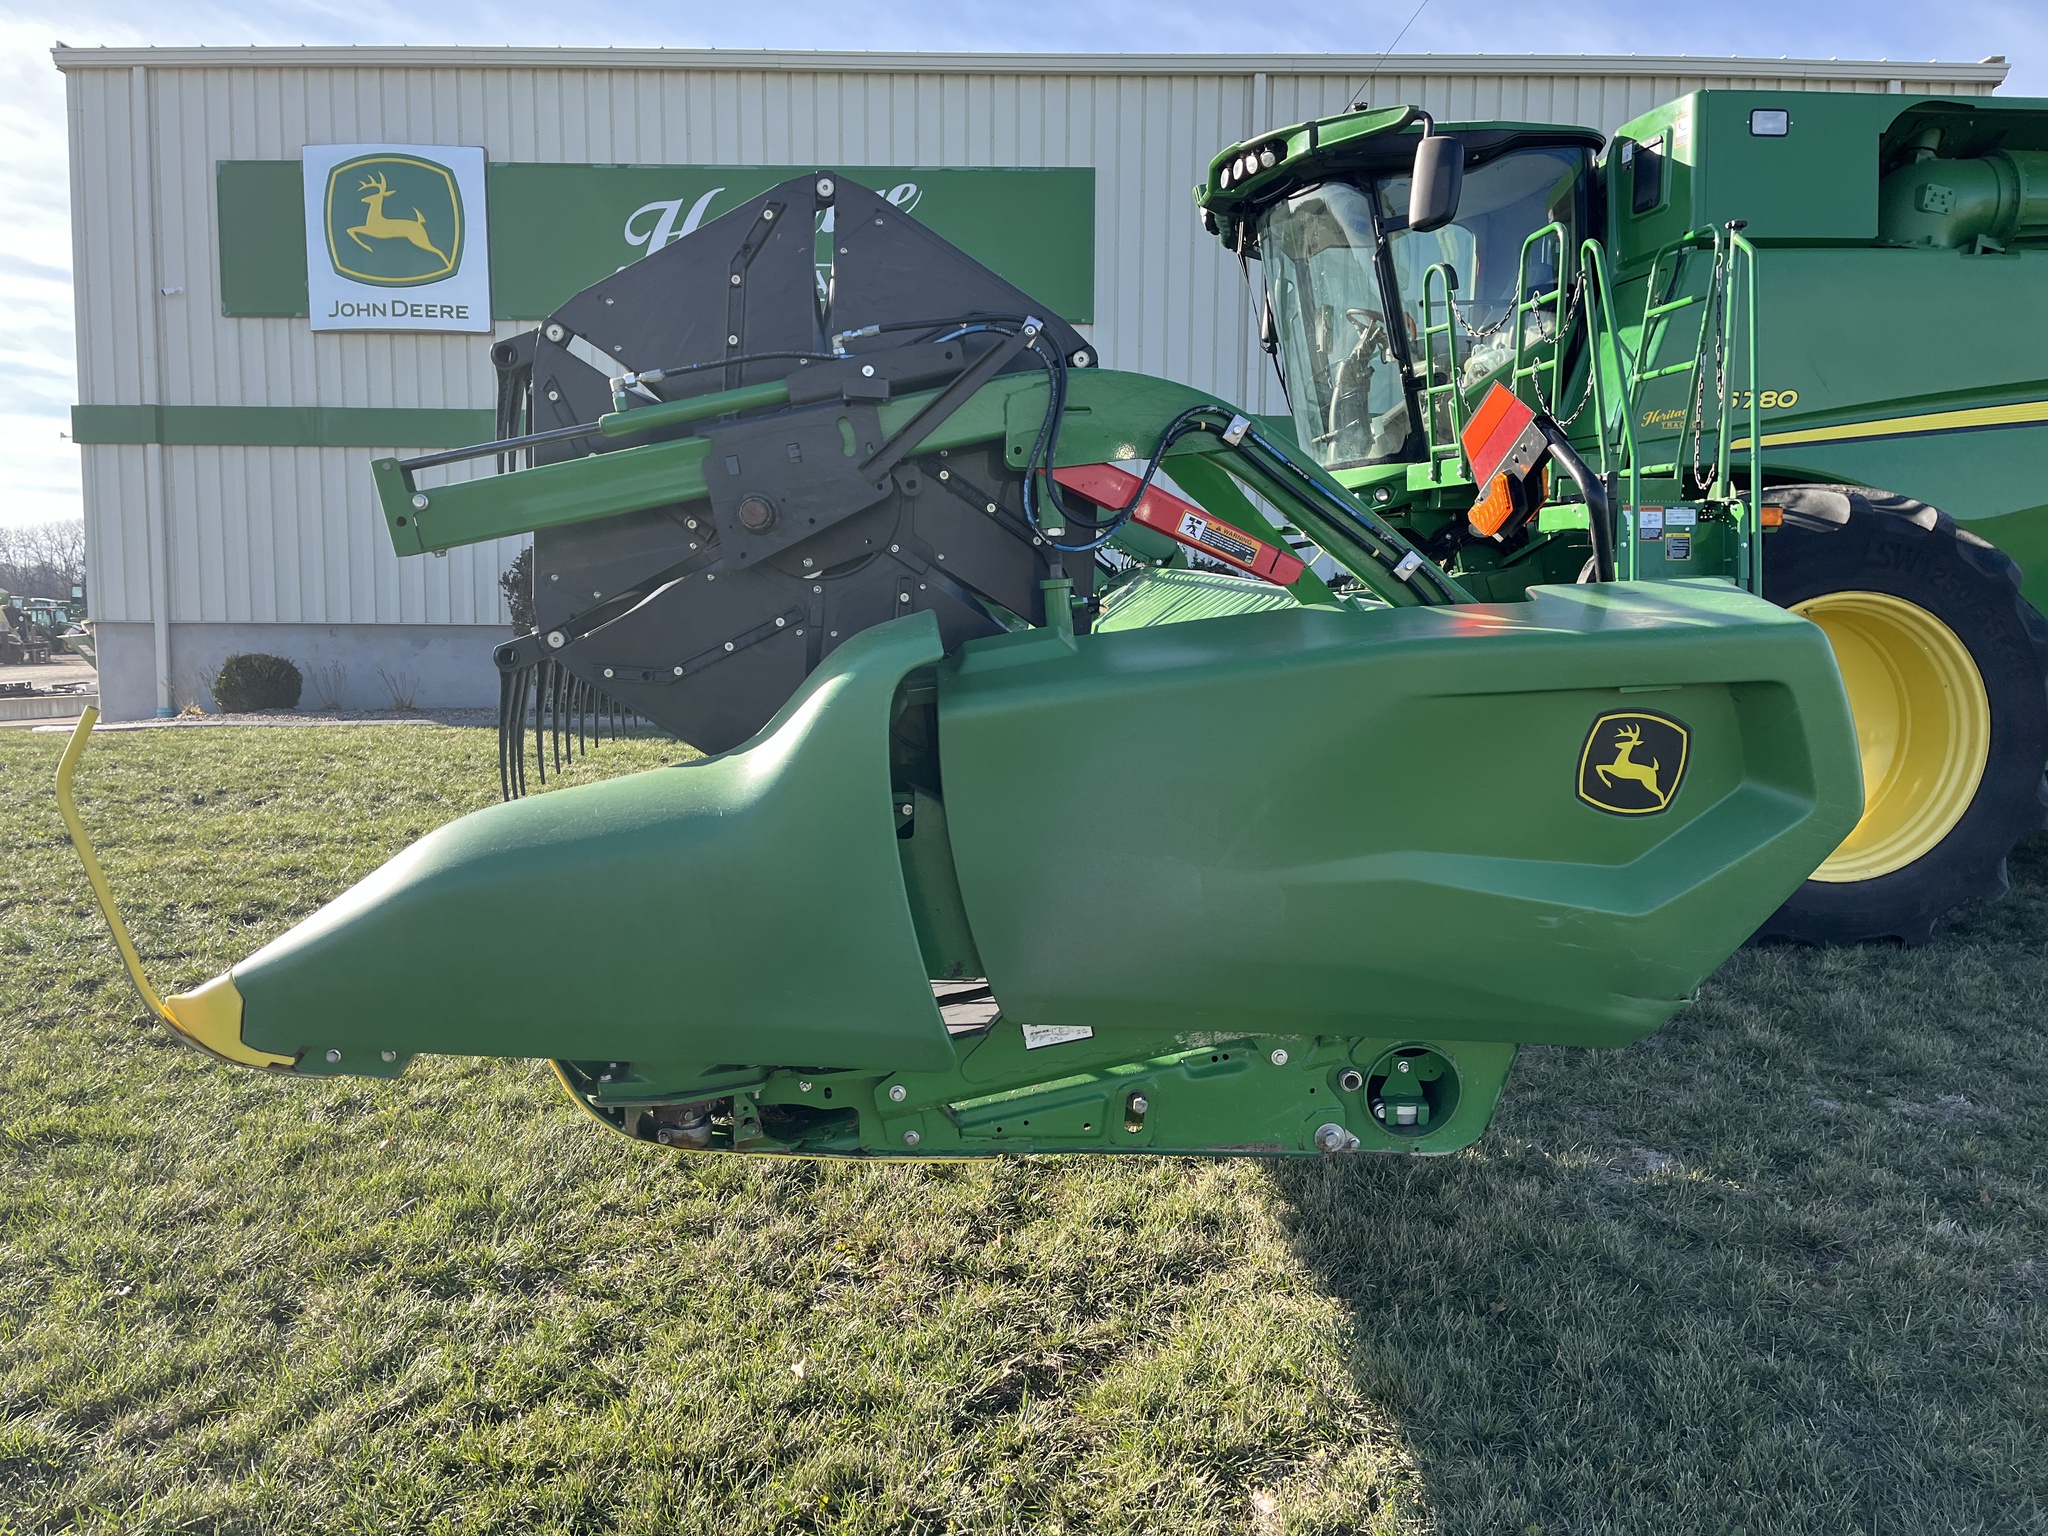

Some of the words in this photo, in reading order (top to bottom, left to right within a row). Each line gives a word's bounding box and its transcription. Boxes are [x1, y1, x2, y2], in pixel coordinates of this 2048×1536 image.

[328, 299, 387, 318] JOHN
[391, 299, 469, 320] DEERE
[1641, 408, 1687, 427] Heritag
[1222, 527, 1253, 546] WARNING
